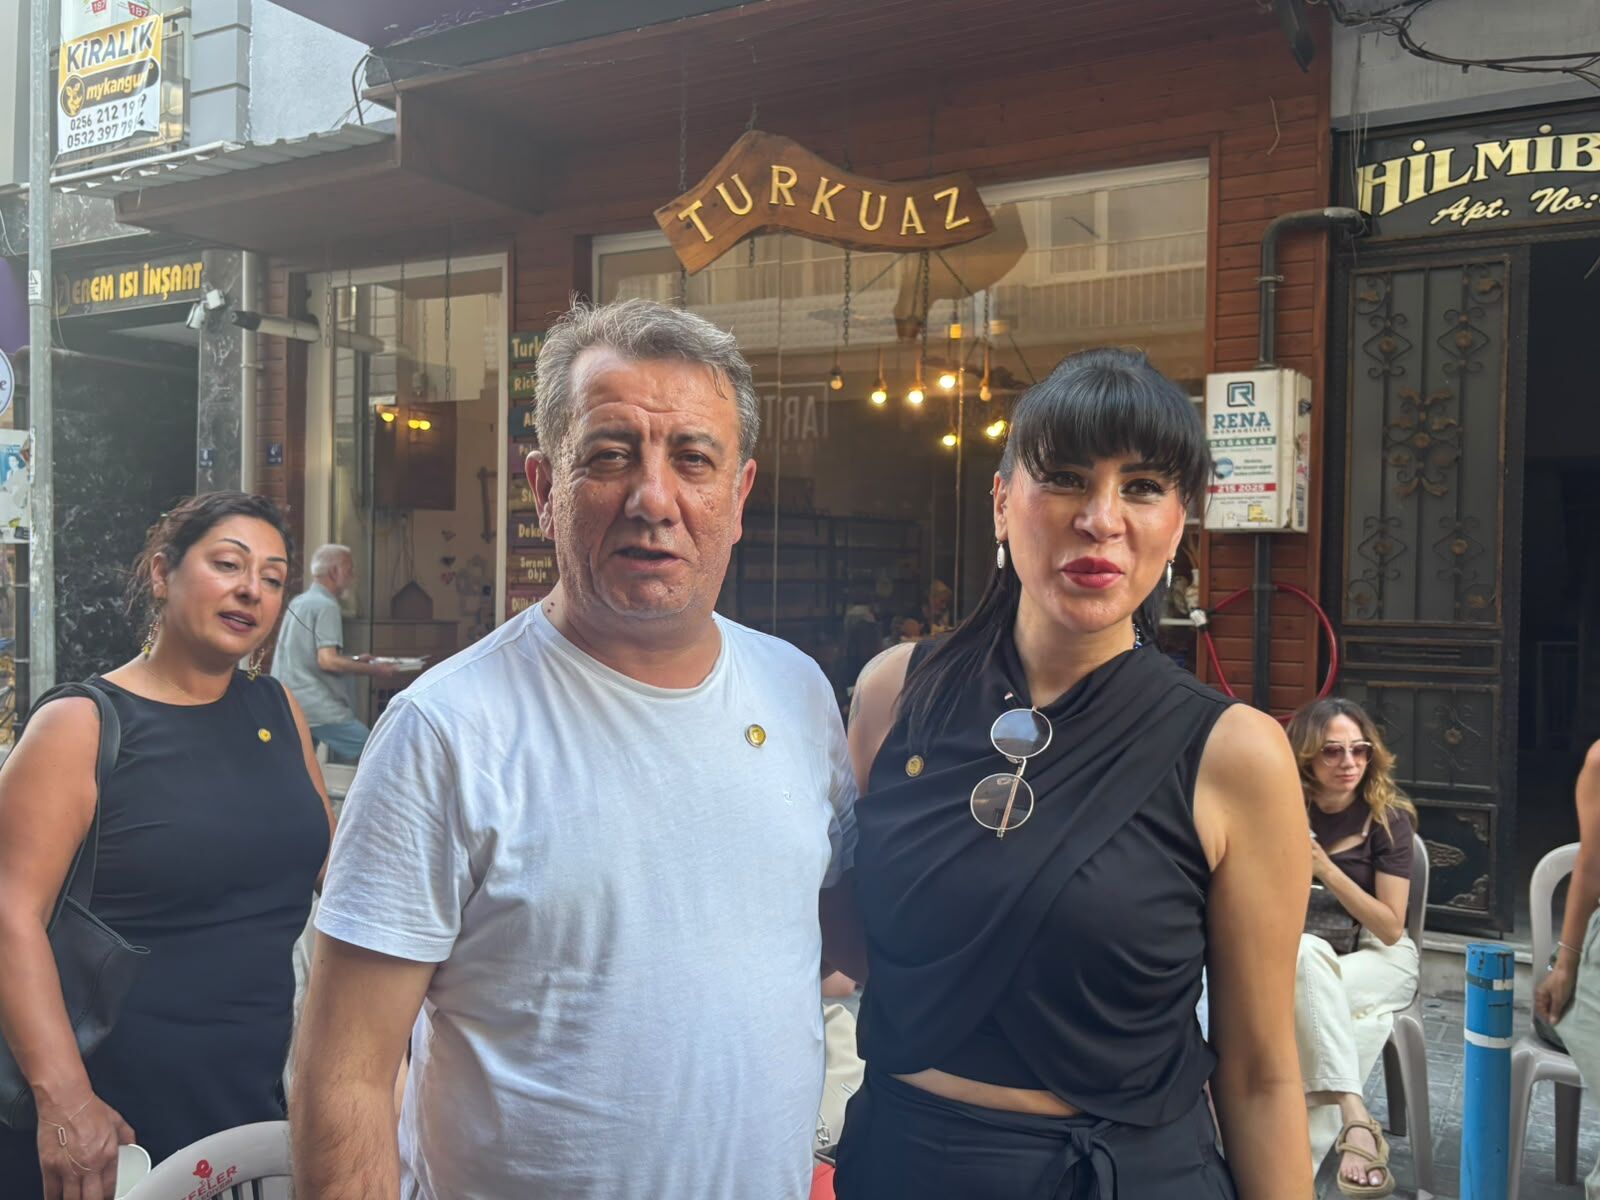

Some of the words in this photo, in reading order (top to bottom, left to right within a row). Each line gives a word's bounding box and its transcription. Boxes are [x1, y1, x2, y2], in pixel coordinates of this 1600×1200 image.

[67, 21, 153, 73] KİRALIK
[70, 115, 92, 131] 0256
[97, 105, 118, 124] 212
[67, 130, 95, 149] 0532
[97, 123, 119, 141] 397
[678, 165, 970, 242] TURKUAZ
[1430, 196, 1512, 226] Apt.
[119, 271, 139, 299] ISI
[143, 262, 203, 300] İNŞAAT
[1213, 412, 1271, 429] RENA
